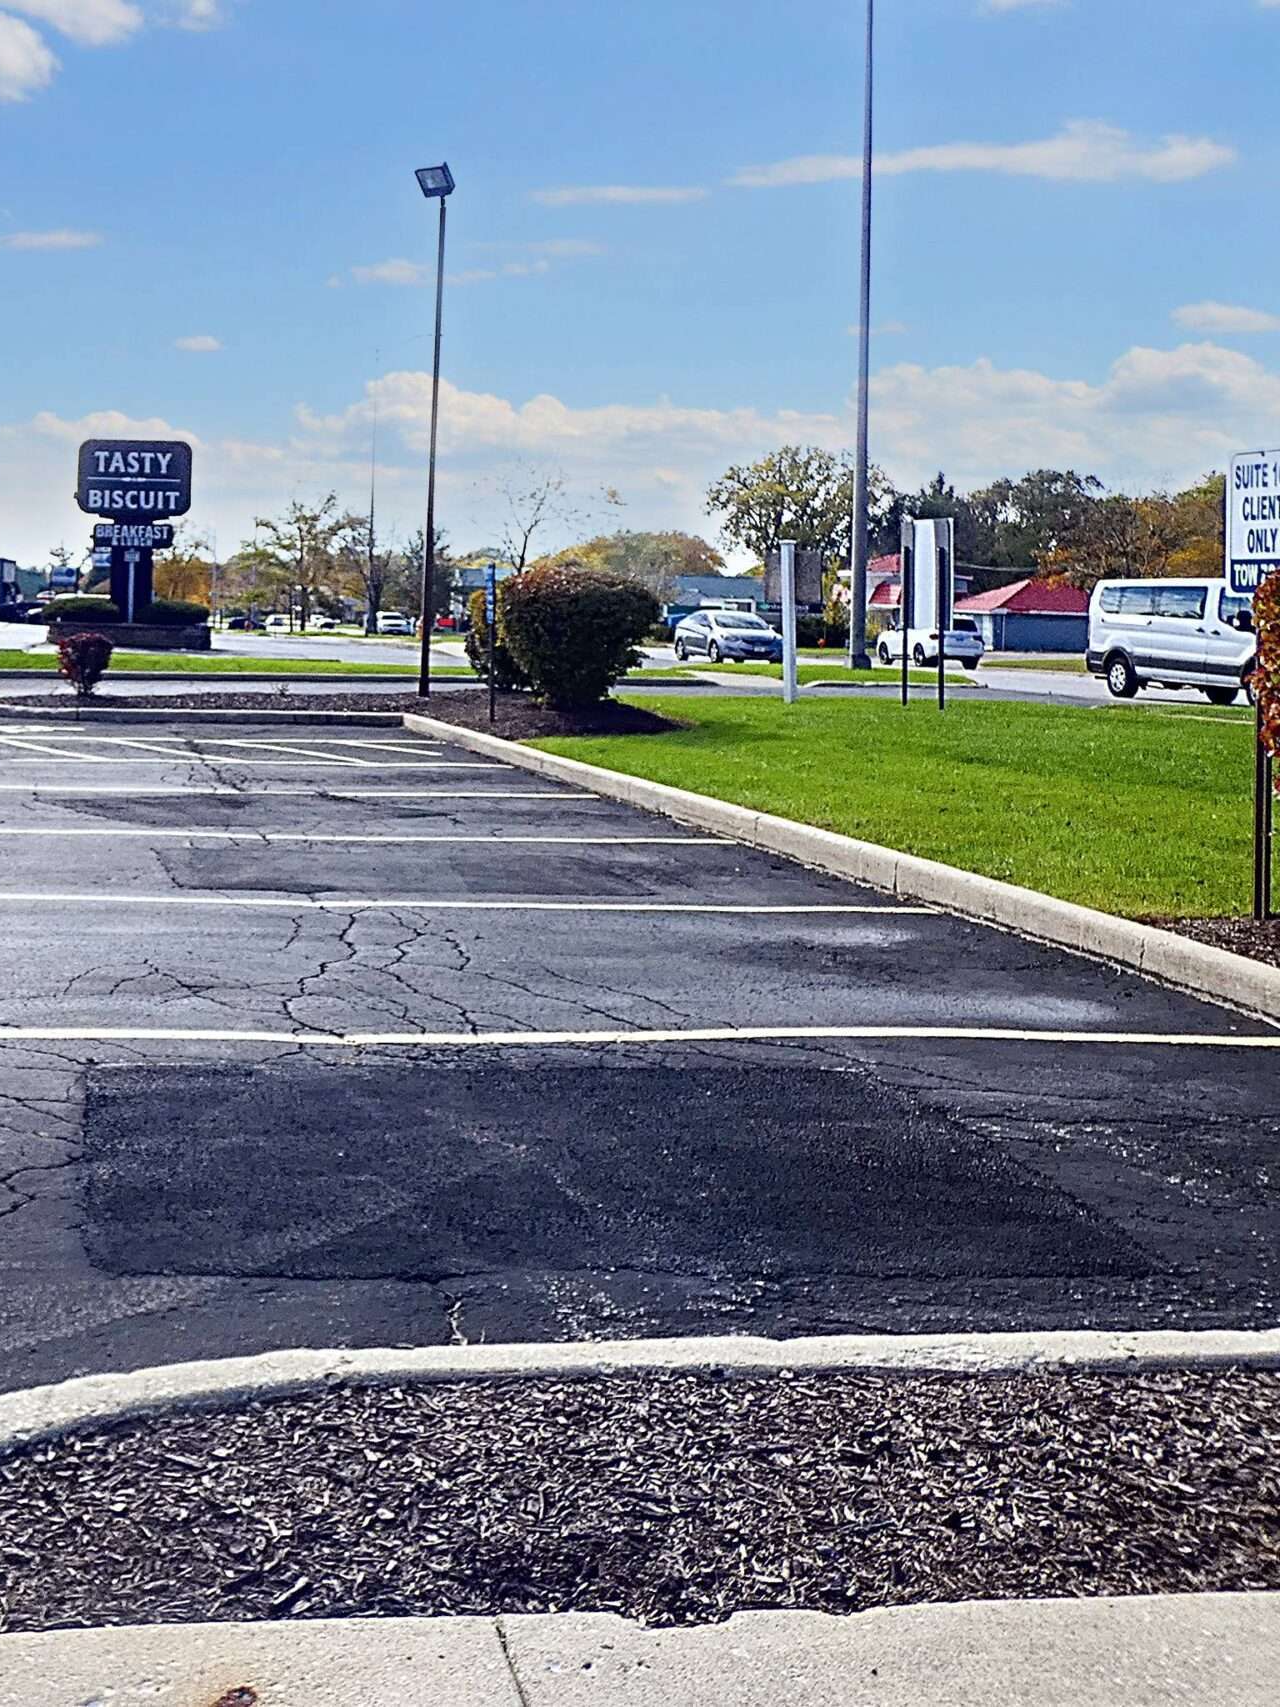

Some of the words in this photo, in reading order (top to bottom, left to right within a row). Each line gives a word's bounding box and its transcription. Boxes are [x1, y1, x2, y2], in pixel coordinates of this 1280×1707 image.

[94, 451, 173, 474] TASTY
[1234, 463, 1269, 490] SUITE
[1272, 461, 1280, 487] 1
[87, 489, 181, 510] BISCUIT
[95, 525, 170, 540] BREAKFAST
[121, 536, 153, 547] LUNCH
[1247, 528, 1278, 554] ONLY
[1233, 563, 1259, 587] TOW
